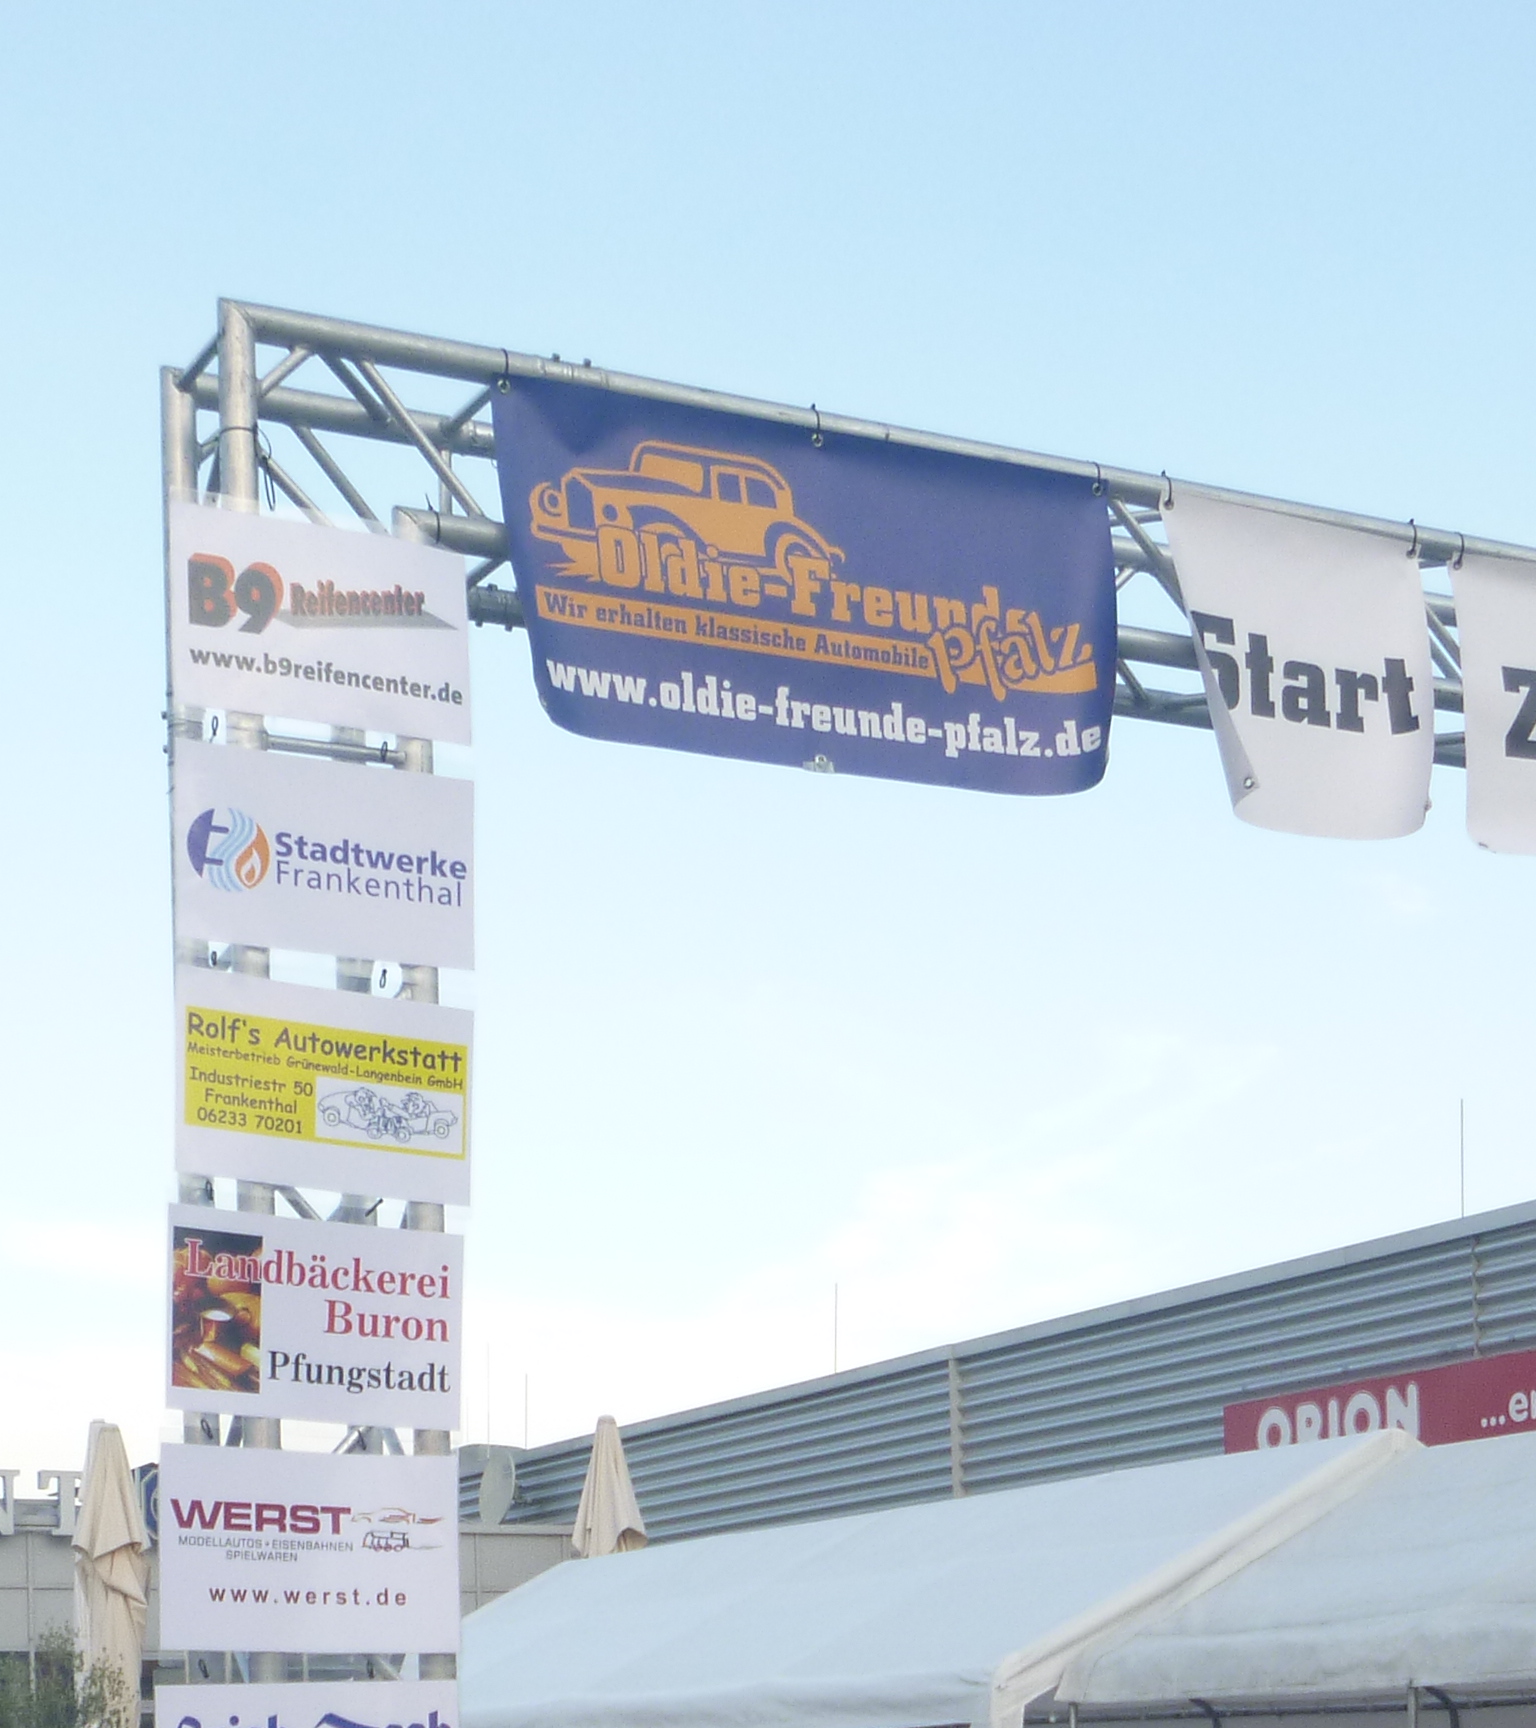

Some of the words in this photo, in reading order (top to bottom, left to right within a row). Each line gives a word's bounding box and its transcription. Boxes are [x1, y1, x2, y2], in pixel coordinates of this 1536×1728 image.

[188, 553, 284, 634] B9
[290, 580, 425, 616] Reifencenter
[544, 592, 586, 618] Wir
[596, 605, 687, 634] erhalten
[695, 616, 806, 651] klassische
[814, 633, 929, 669] Automobile
[190, 648, 463, 706] www.b9reifencenter.de
[1190, 610, 1421, 735] Start
[547, 659, 1102, 759] www.oldie-freunde-pfalz.de
[275, 832, 466, 880] Stadtwerke
[276, 861, 462, 907] Frankenthal
[188, 1043, 281, 1066] Meisterbetrieb
[287, 1056, 422, 1085] Grünewald-Langenbein
[427, 1075, 463, 1090] GmbH
[274, 1027, 462, 1072] Autowerkstatt
[190, 1067, 285, 1094] Industriestr
[294, 1082, 313, 1097] 50
[205, 1088, 297, 1114] Frankenthal
[197, 1108, 247, 1126] 06233
[256, 1116, 302, 1134] 70201
[185, 1238, 450, 1299] Landbäckerei
[324, 1300, 449, 1342] Buron
[268, 1351, 450, 1394] Pfungstadt
[1258, 1382, 1420, 1449] ORION
[170, 1498, 351, 1535] WERST
[178, 1535, 262, 1549] MODELLAUTOS
[272, 1539, 354, 1551] EISENBAHNEN
[226, 1550, 298, 1562] SPIELWAREN
[210, 1587, 407, 1606] www.werst.de
